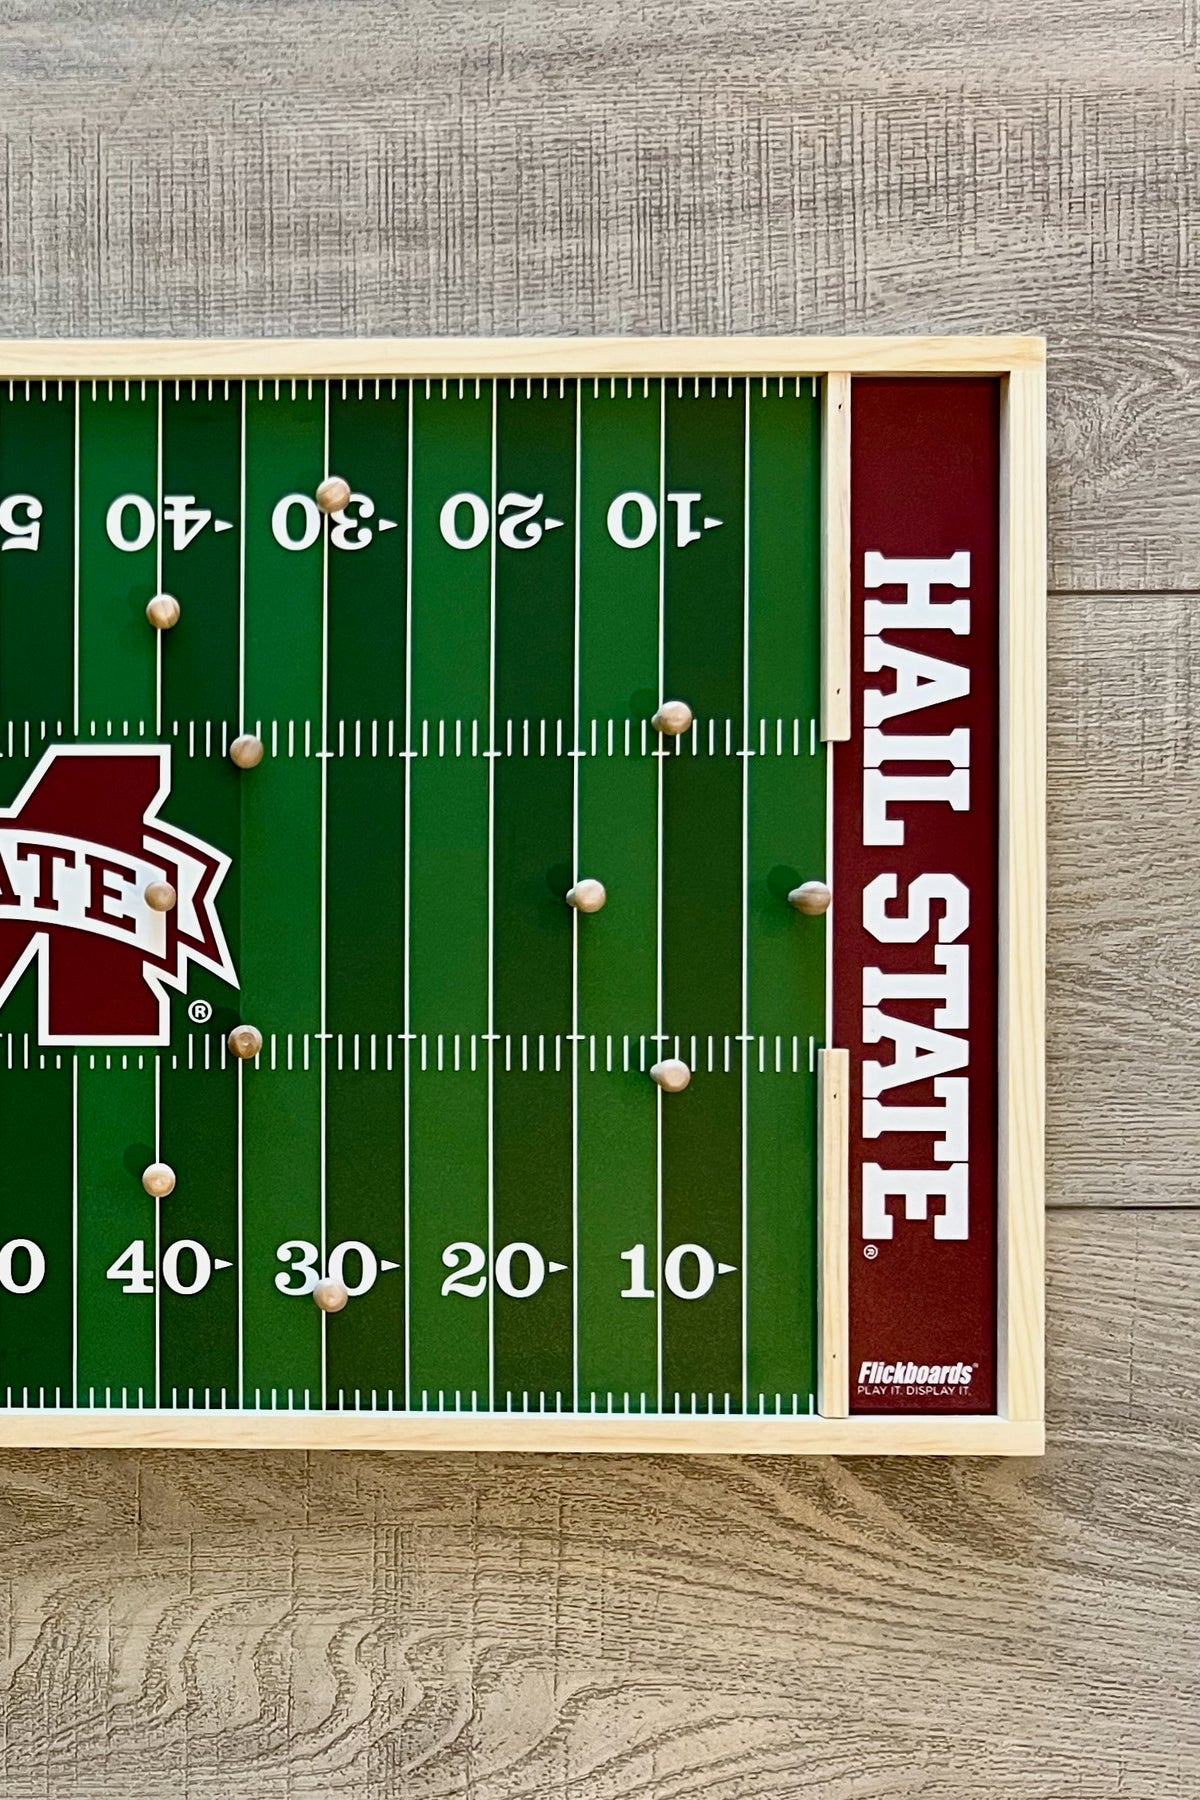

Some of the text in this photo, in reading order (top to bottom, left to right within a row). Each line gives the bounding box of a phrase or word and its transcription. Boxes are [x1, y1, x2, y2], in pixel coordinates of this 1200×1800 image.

[106, 494, 212, 551] 40
[272, 493, 375, 551] 30
[440, 492, 544, 550] 20
[606, 491, 703, 549] 10
[863, 550, 972, 846] HAIL
[862, 873, 970, 1241] STATE
[106, 1239, 211, 1294] 40
[275, 1240, 377, 1296] 30
[442, 1241, 544, 1297] 20
[621, 1243, 714, 1299] 10
[857, 1386, 887, 1395] PLAY
[906, 1386, 956, 1396] DISPLAY
[858, 1361, 973, 1384] Flickboards
